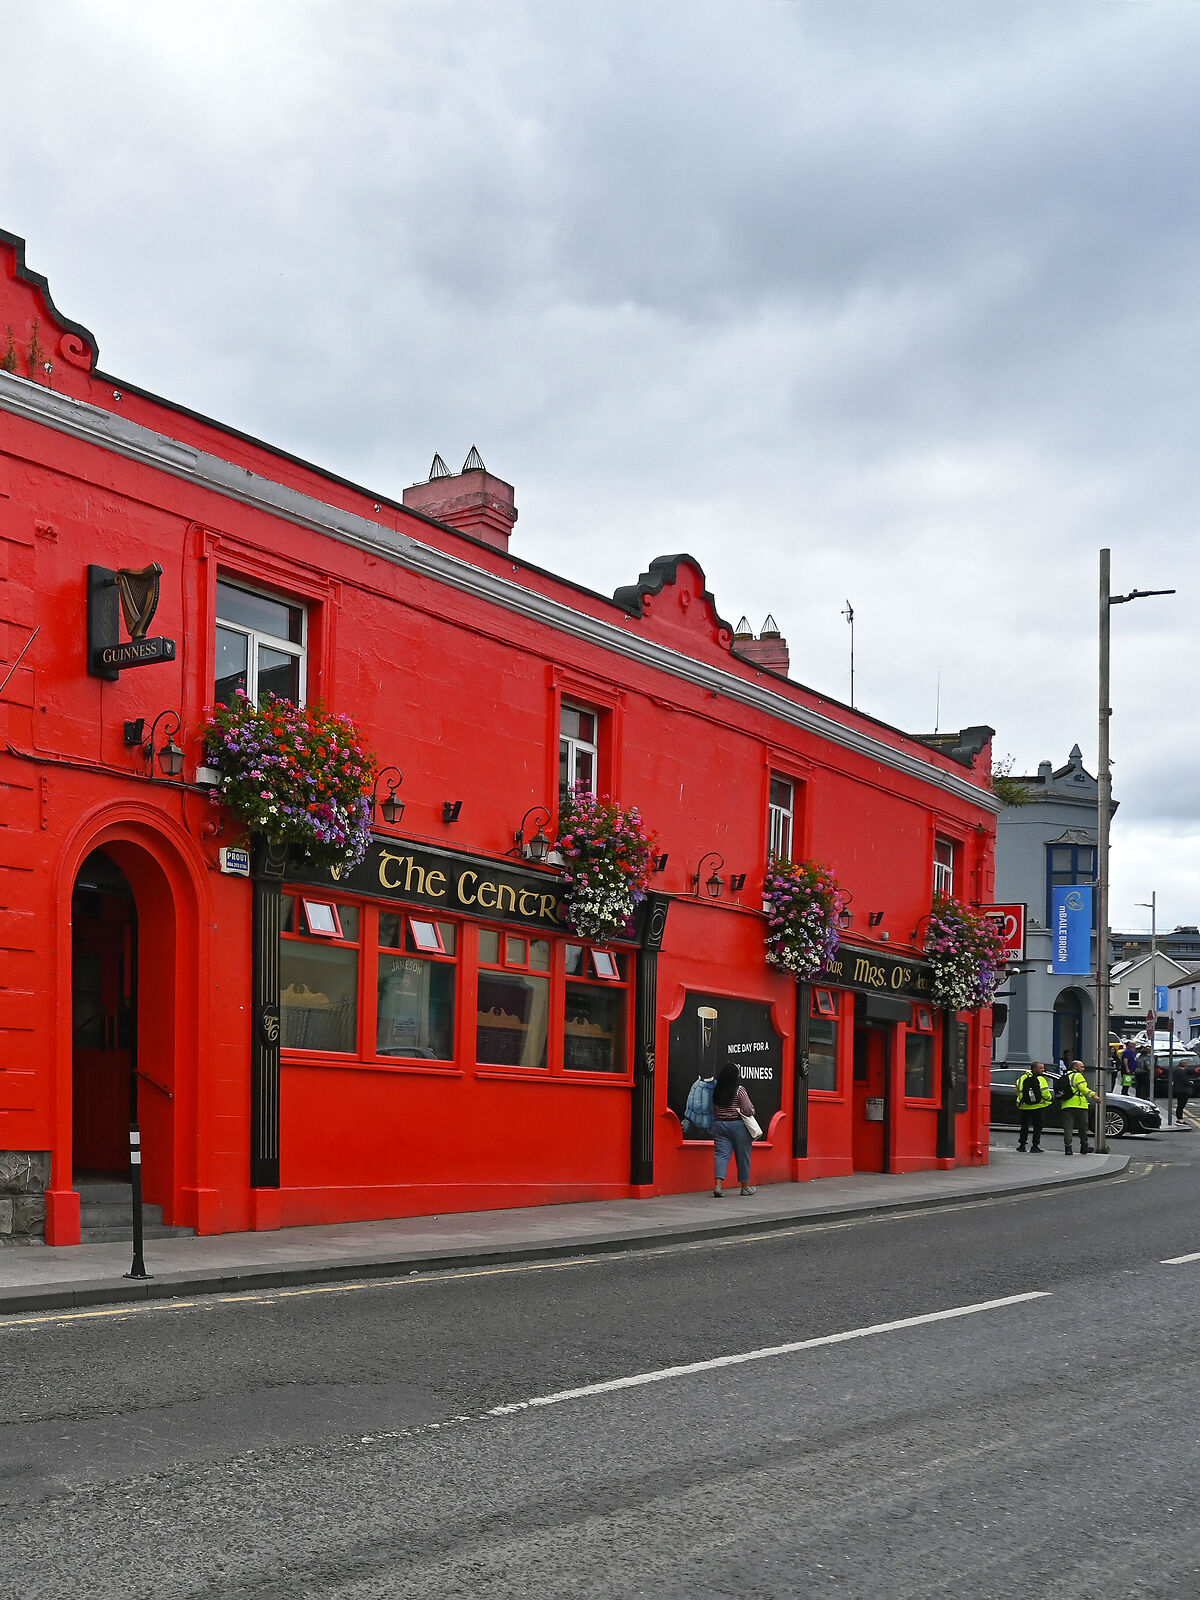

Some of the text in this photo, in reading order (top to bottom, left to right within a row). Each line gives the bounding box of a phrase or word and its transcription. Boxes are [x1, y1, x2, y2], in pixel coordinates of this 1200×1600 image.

[103, 643, 158, 663] GUINNESS
[378, 849, 447, 897] The
[727, 1041, 770, 1053] NICE DAY FOR A
